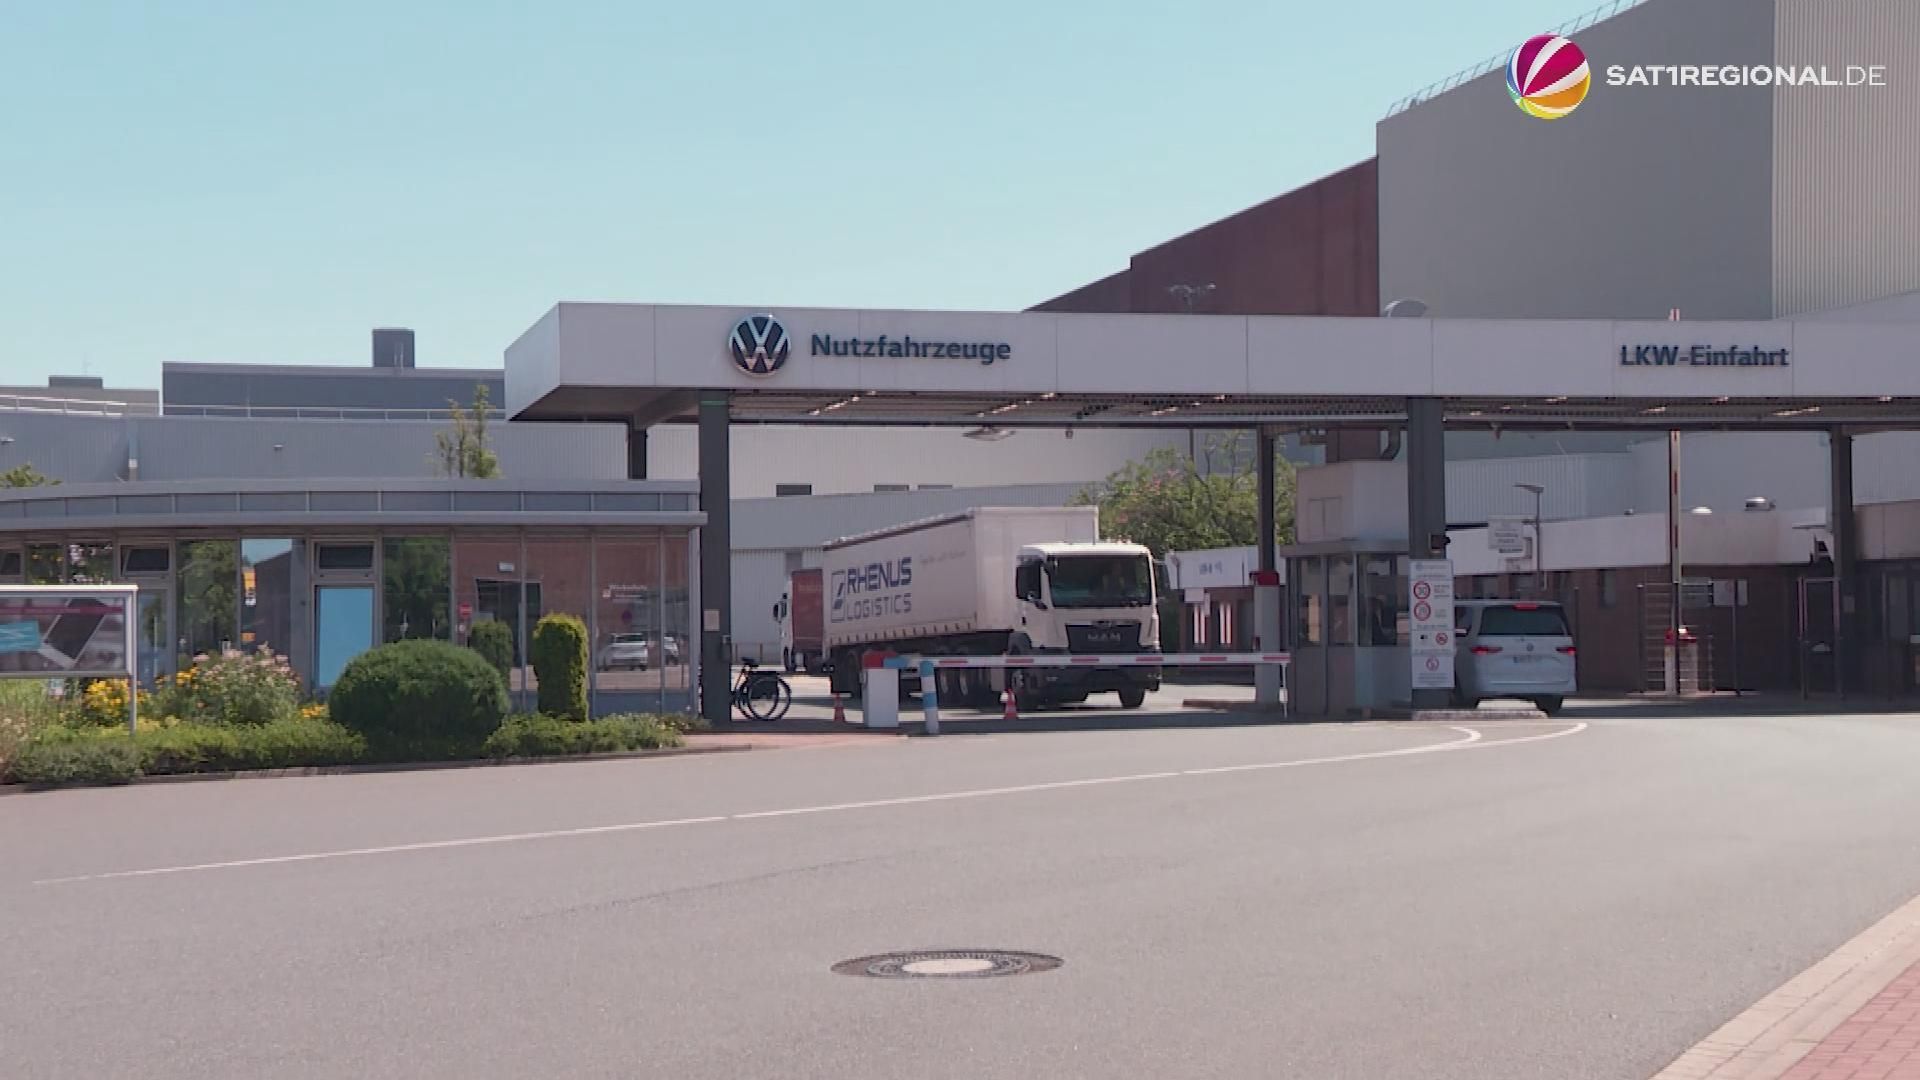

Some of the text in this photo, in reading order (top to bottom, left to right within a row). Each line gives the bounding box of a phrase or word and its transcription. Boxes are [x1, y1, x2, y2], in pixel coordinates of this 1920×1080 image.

[811, 333, 1012, 366] Nutzfahrzeuge
[1620, 344, 1791, 366] LKW-Einfahrt
[847, 556, 912, 594] RHENUS
[846, 593, 912, 621] LOGISTICS
